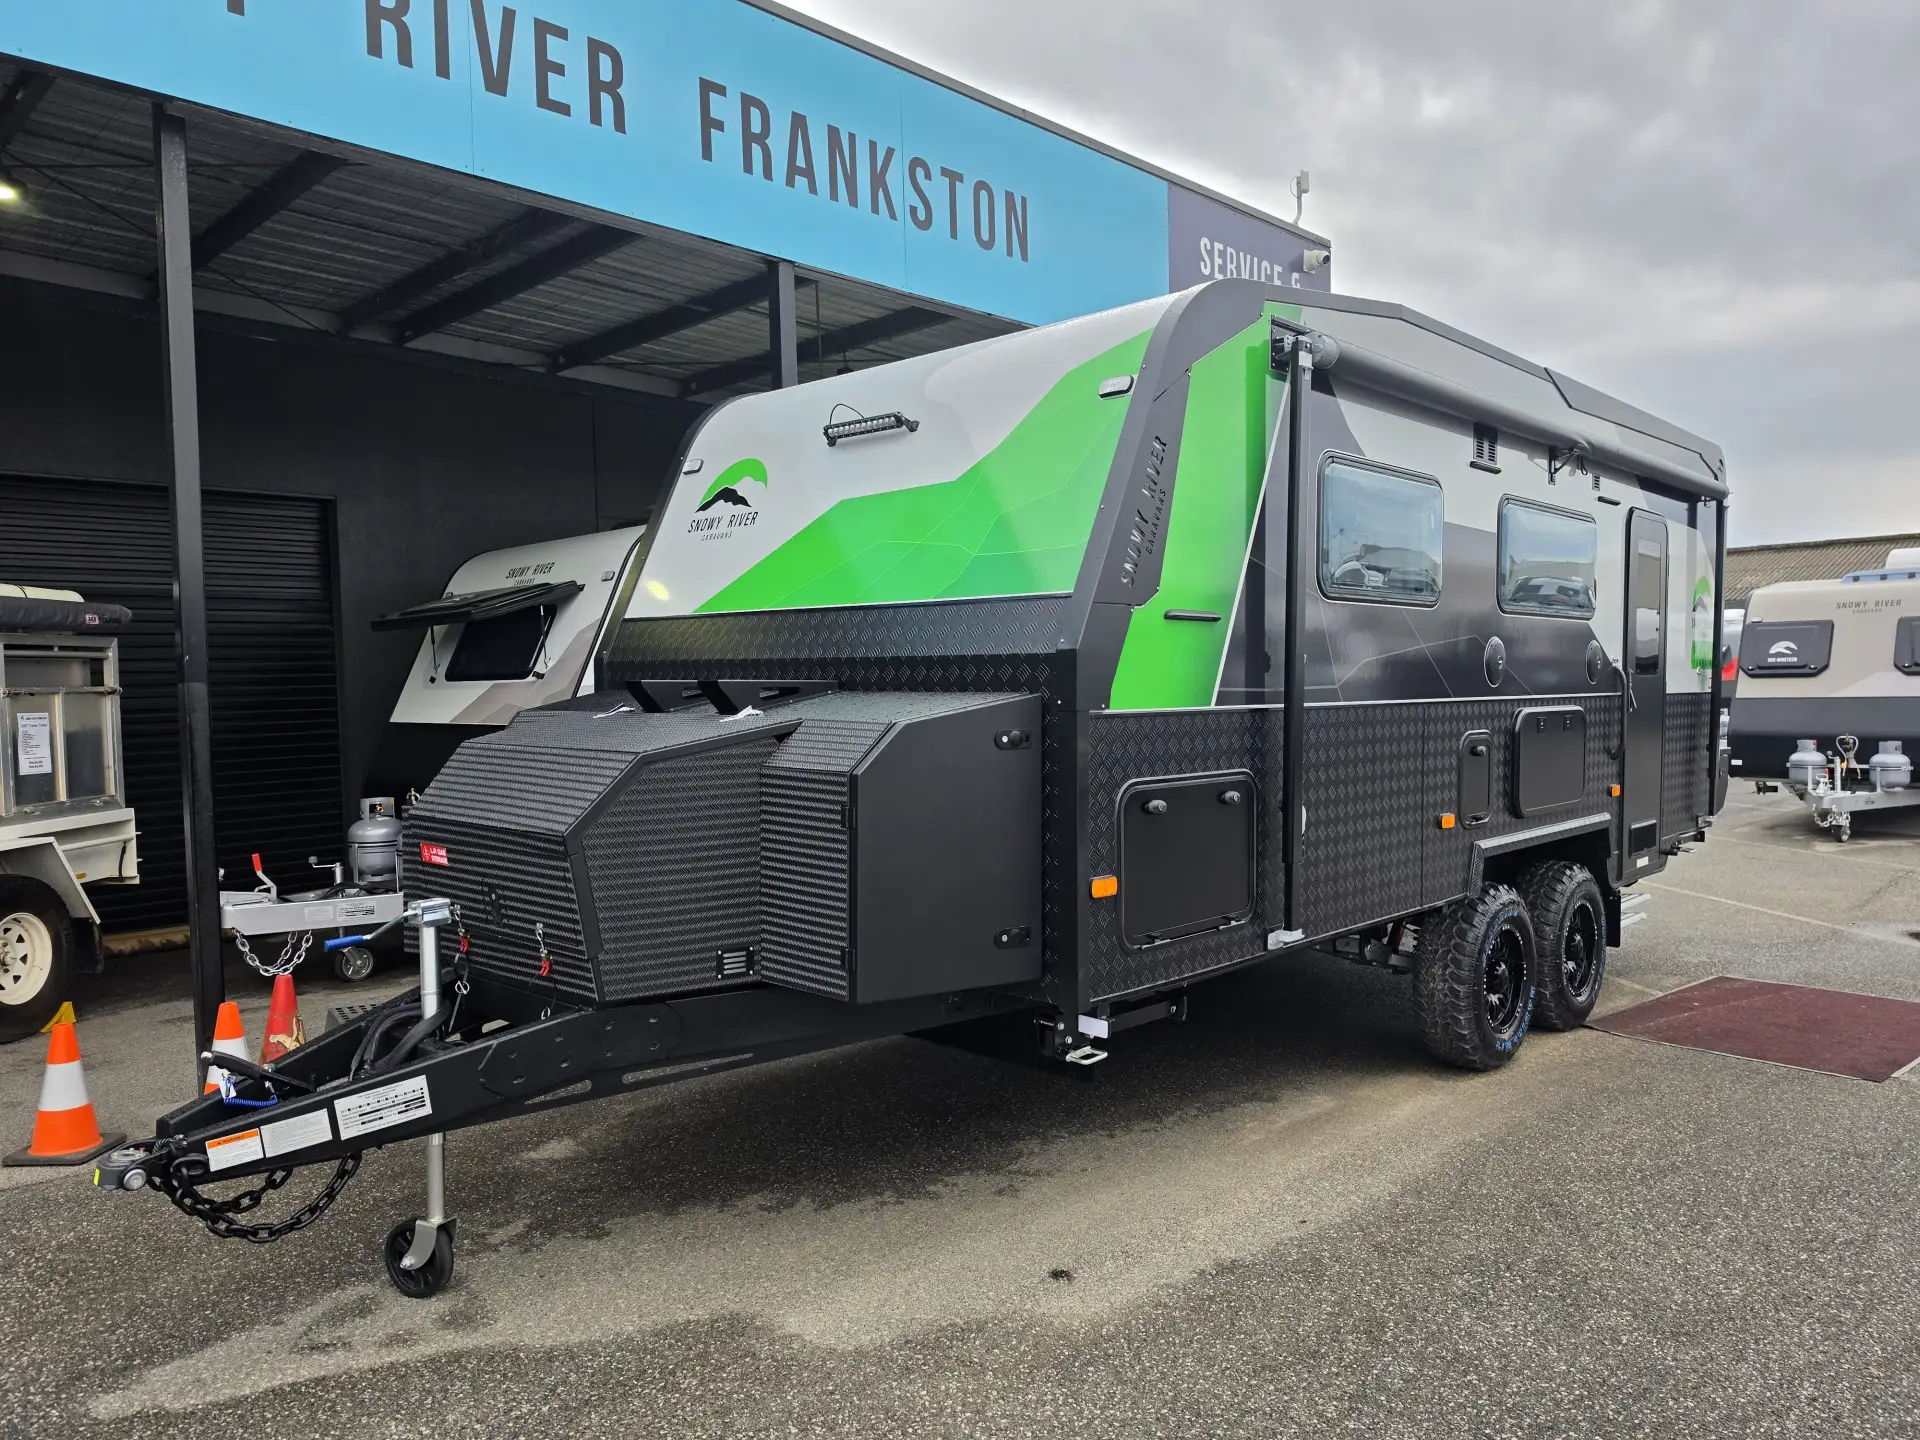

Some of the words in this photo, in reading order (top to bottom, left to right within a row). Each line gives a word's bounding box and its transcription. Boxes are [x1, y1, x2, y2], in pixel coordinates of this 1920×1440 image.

[365, 0, 627, 135] RIVER
[699, 77, 1029, 263] FRANKSTON
[1200, 236, 1283, 286] SERVICE
[687, 516, 724, 533] SNOWY
[727, 511, 759, 528] RIVER
[1121, 508, 1149, 588] SNOWY
[1141, 435, 1168, 500] RIVER
[1145, 488, 1167, 555] CARAVANS
[701, 531, 733, 542] CARAVANS
[505, 565, 532, 579] SNOWY
[532, 562, 555, 575] RIVER
[1836, 601, 1868, 609] SNOWY
[1874, 599, 1901, 608] RIVER
